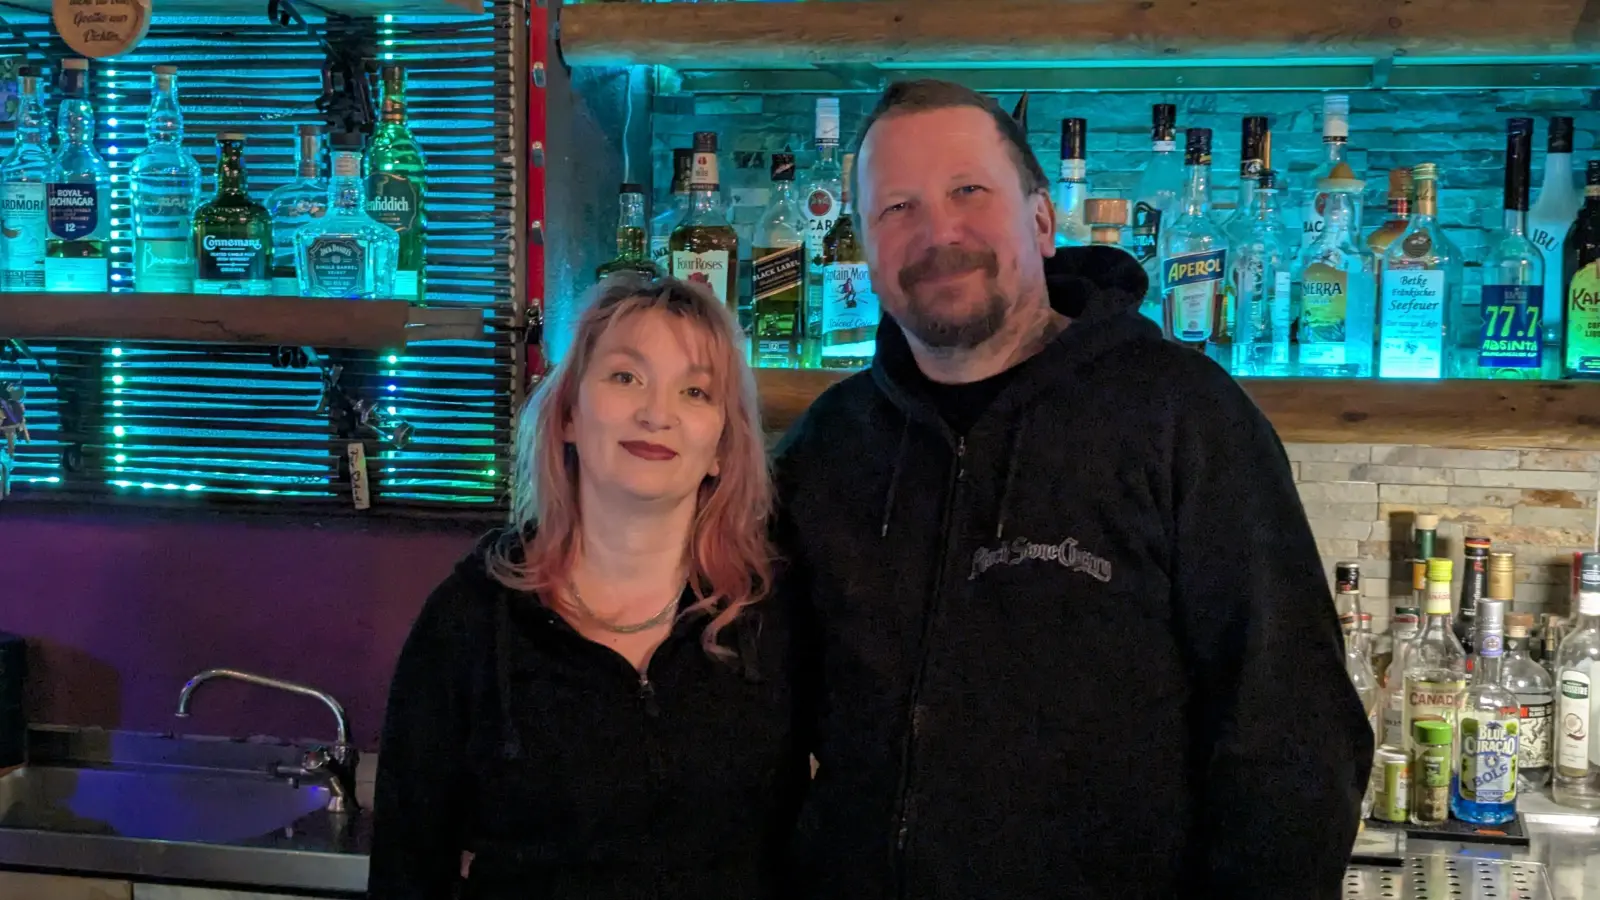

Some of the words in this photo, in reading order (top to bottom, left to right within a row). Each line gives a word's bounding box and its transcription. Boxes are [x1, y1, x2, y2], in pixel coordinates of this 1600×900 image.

[57, 189, 82, 197] ROYAL
[65, 223, 76, 232] 12
[203, 235, 262, 250] Connemara
[677, 257, 693, 270] Four
[695, 257, 723, 270] Roses
[752, 268, 776, 281] BLACK
[776, 259, 800, 273] LABEL
[1168, 258, 1222, 283] APEROL
[1388, 299, 1440, 313] Seefeuer
[1486, 305, 1539, 337] 77.7
[1010, 536, 1058, 565] Stone
[1479, 725, 1506, 740] BLUE
[1472, 763, 1508, 787] BOLS
